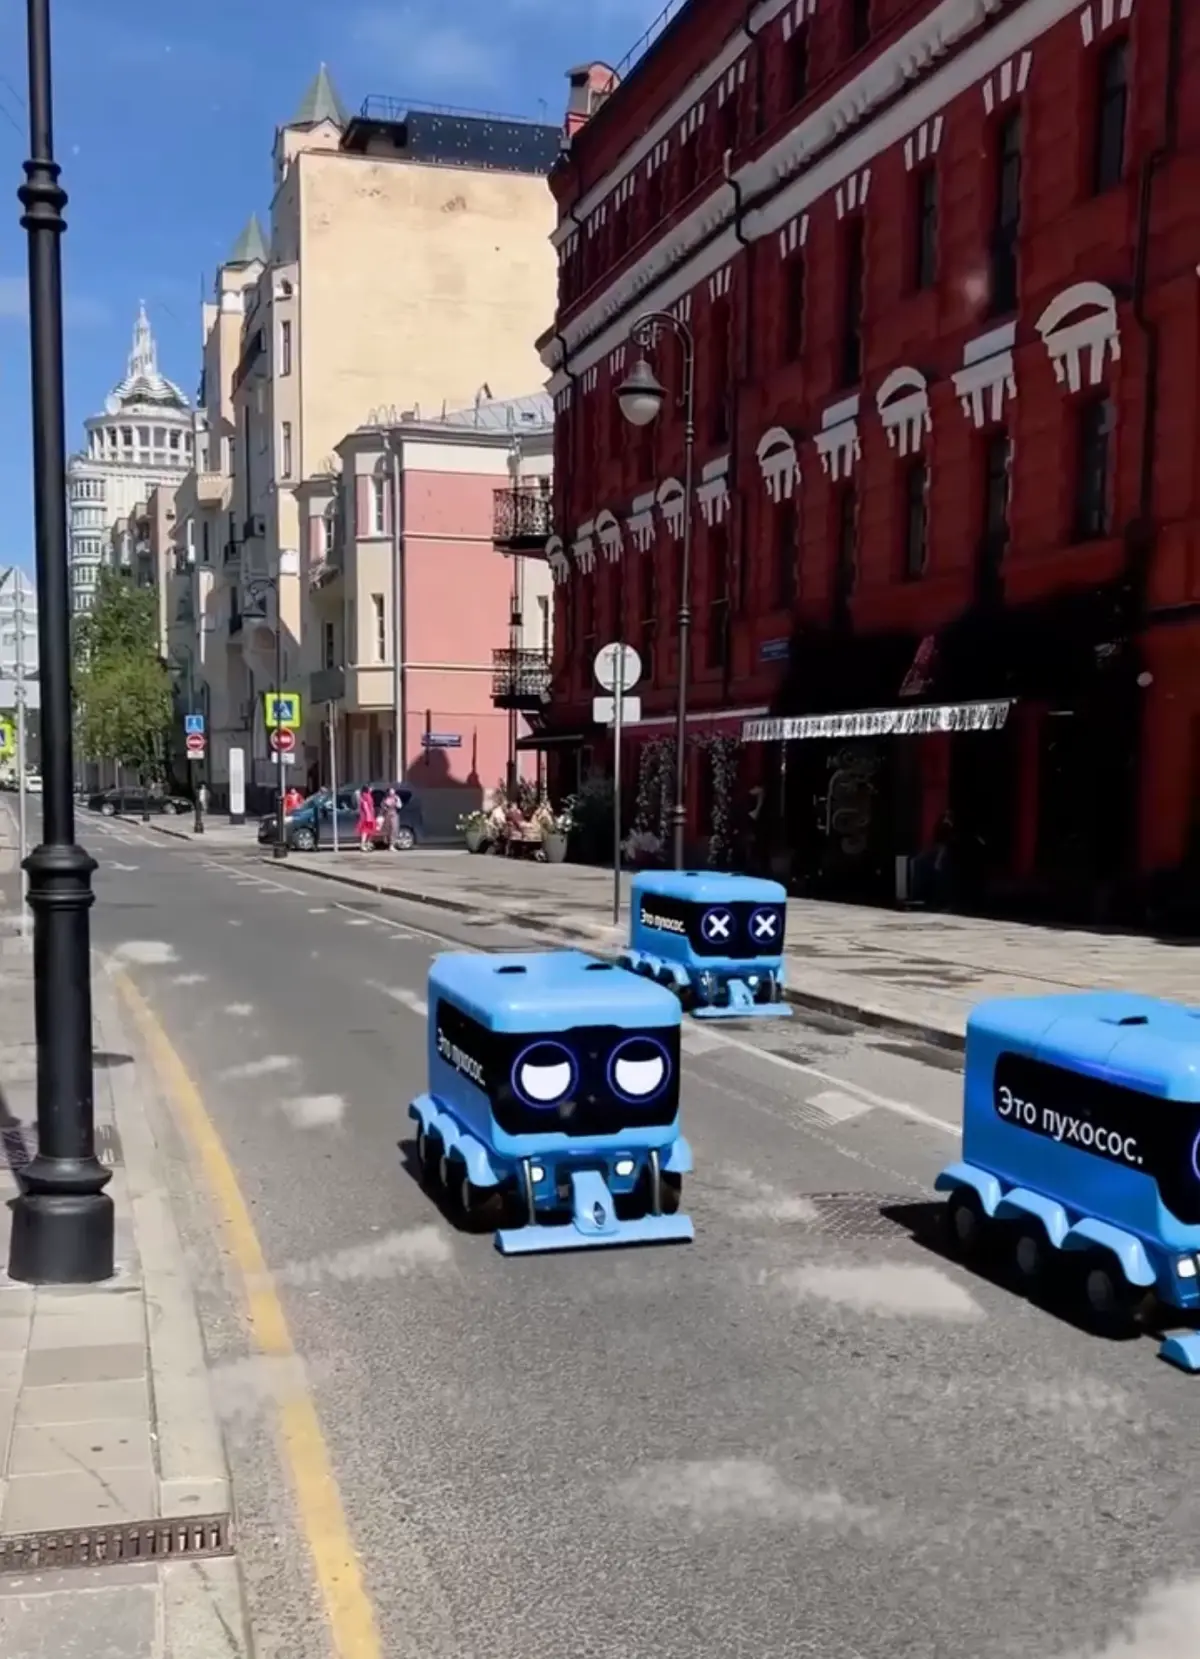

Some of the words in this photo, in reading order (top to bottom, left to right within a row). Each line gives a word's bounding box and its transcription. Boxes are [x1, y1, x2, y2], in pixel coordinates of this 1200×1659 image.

[438, 1028, 451, 1059] Это
[998, 1086, 1037, 1125] Это
[1042, 1108, 1144, 1165] пухосос.
